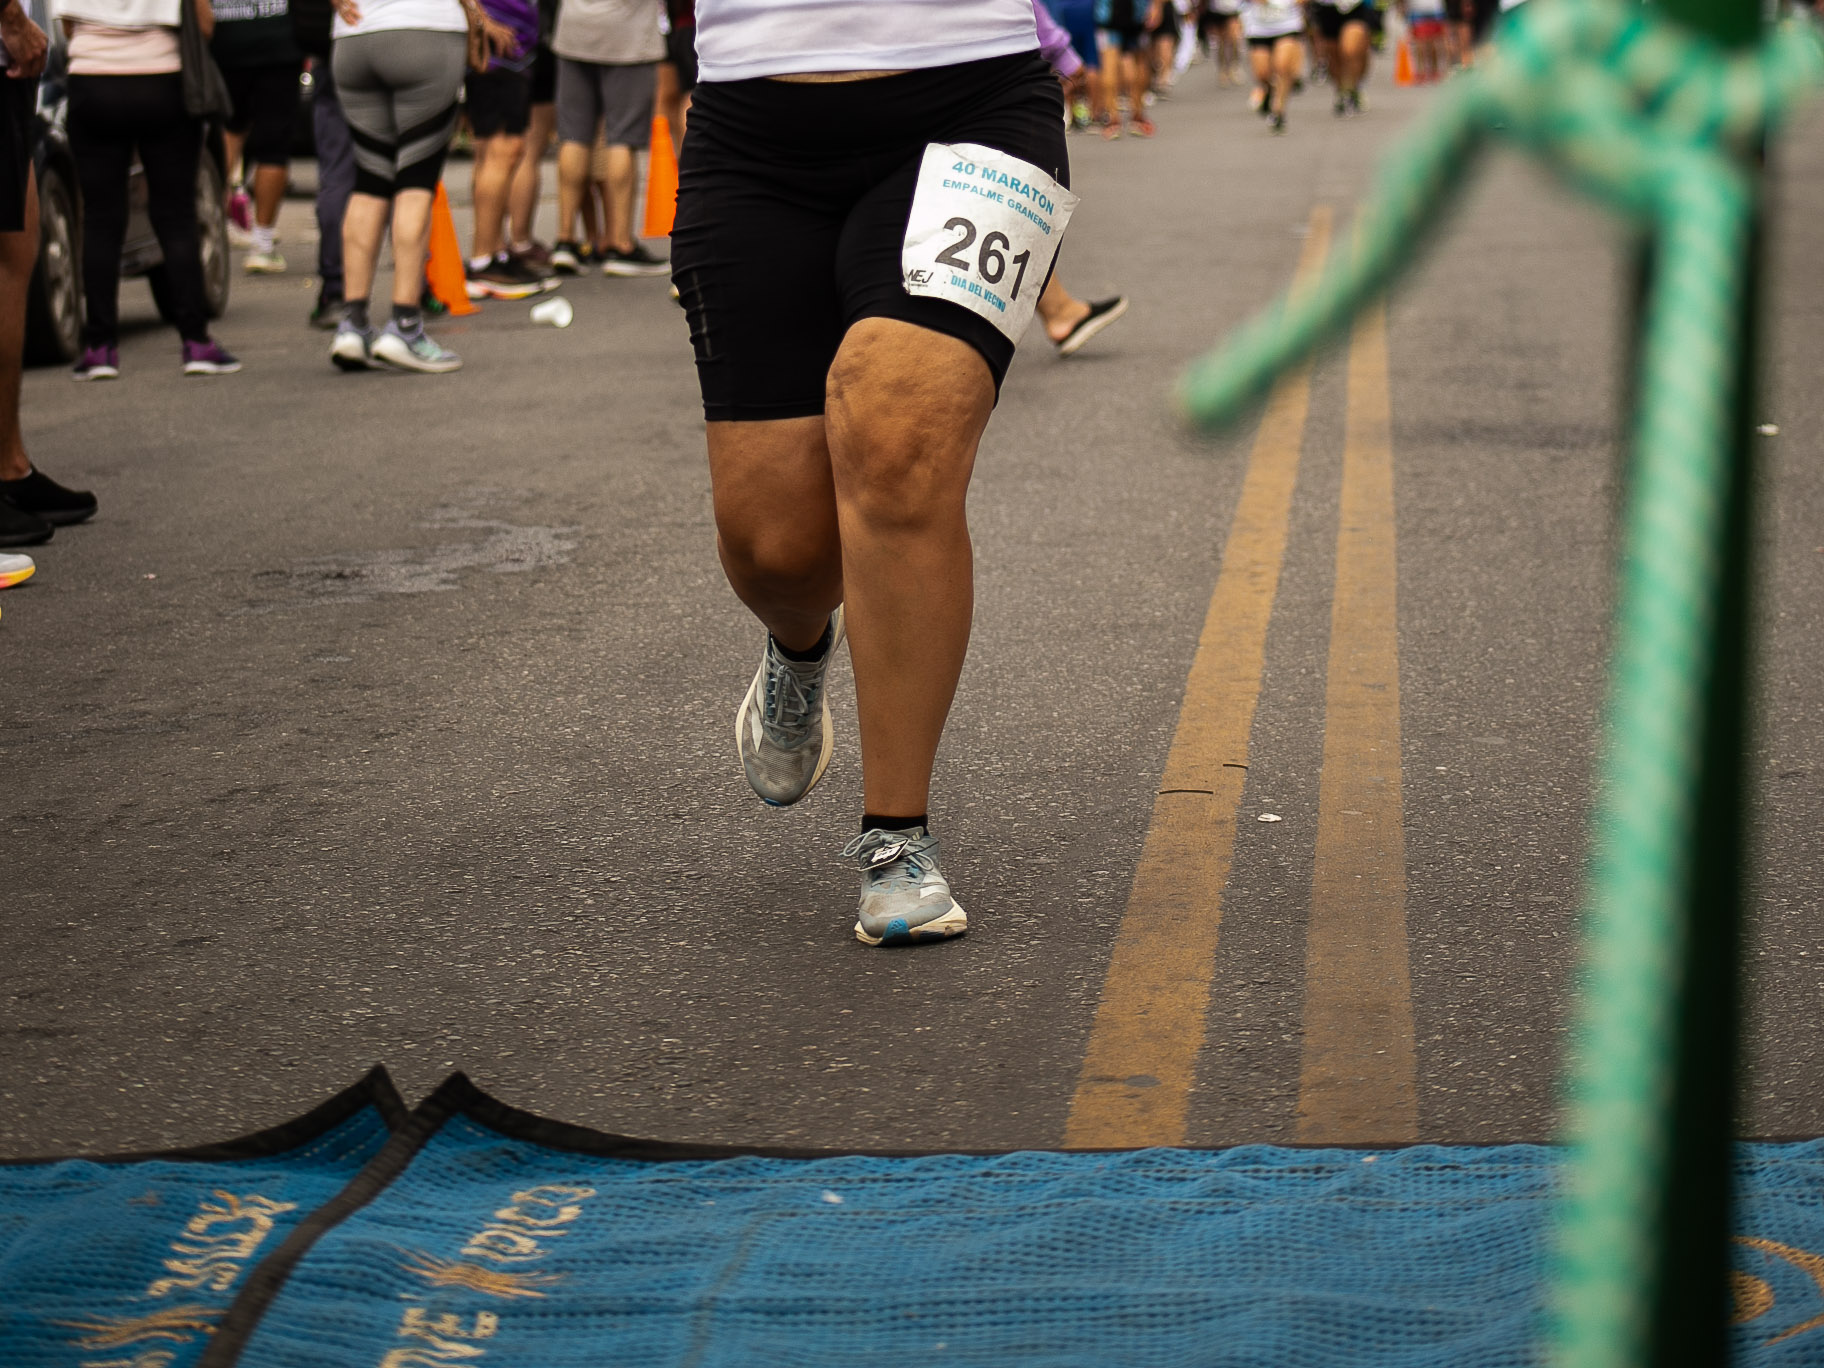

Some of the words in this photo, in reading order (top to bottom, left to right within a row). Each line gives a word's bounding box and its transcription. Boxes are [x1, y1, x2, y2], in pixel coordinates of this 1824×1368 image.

[942, 179, 1005, 204] EMPALME
[1007, 198, 1052, 235] GRANEROS
[952, 161, 976, 175] 40
[981, 167, 1054, 216] MARATON
[934, 217, 1031, 302] 261
[950, 275, 967, 290] DIA
[968, 282, 983, 297] DEL
